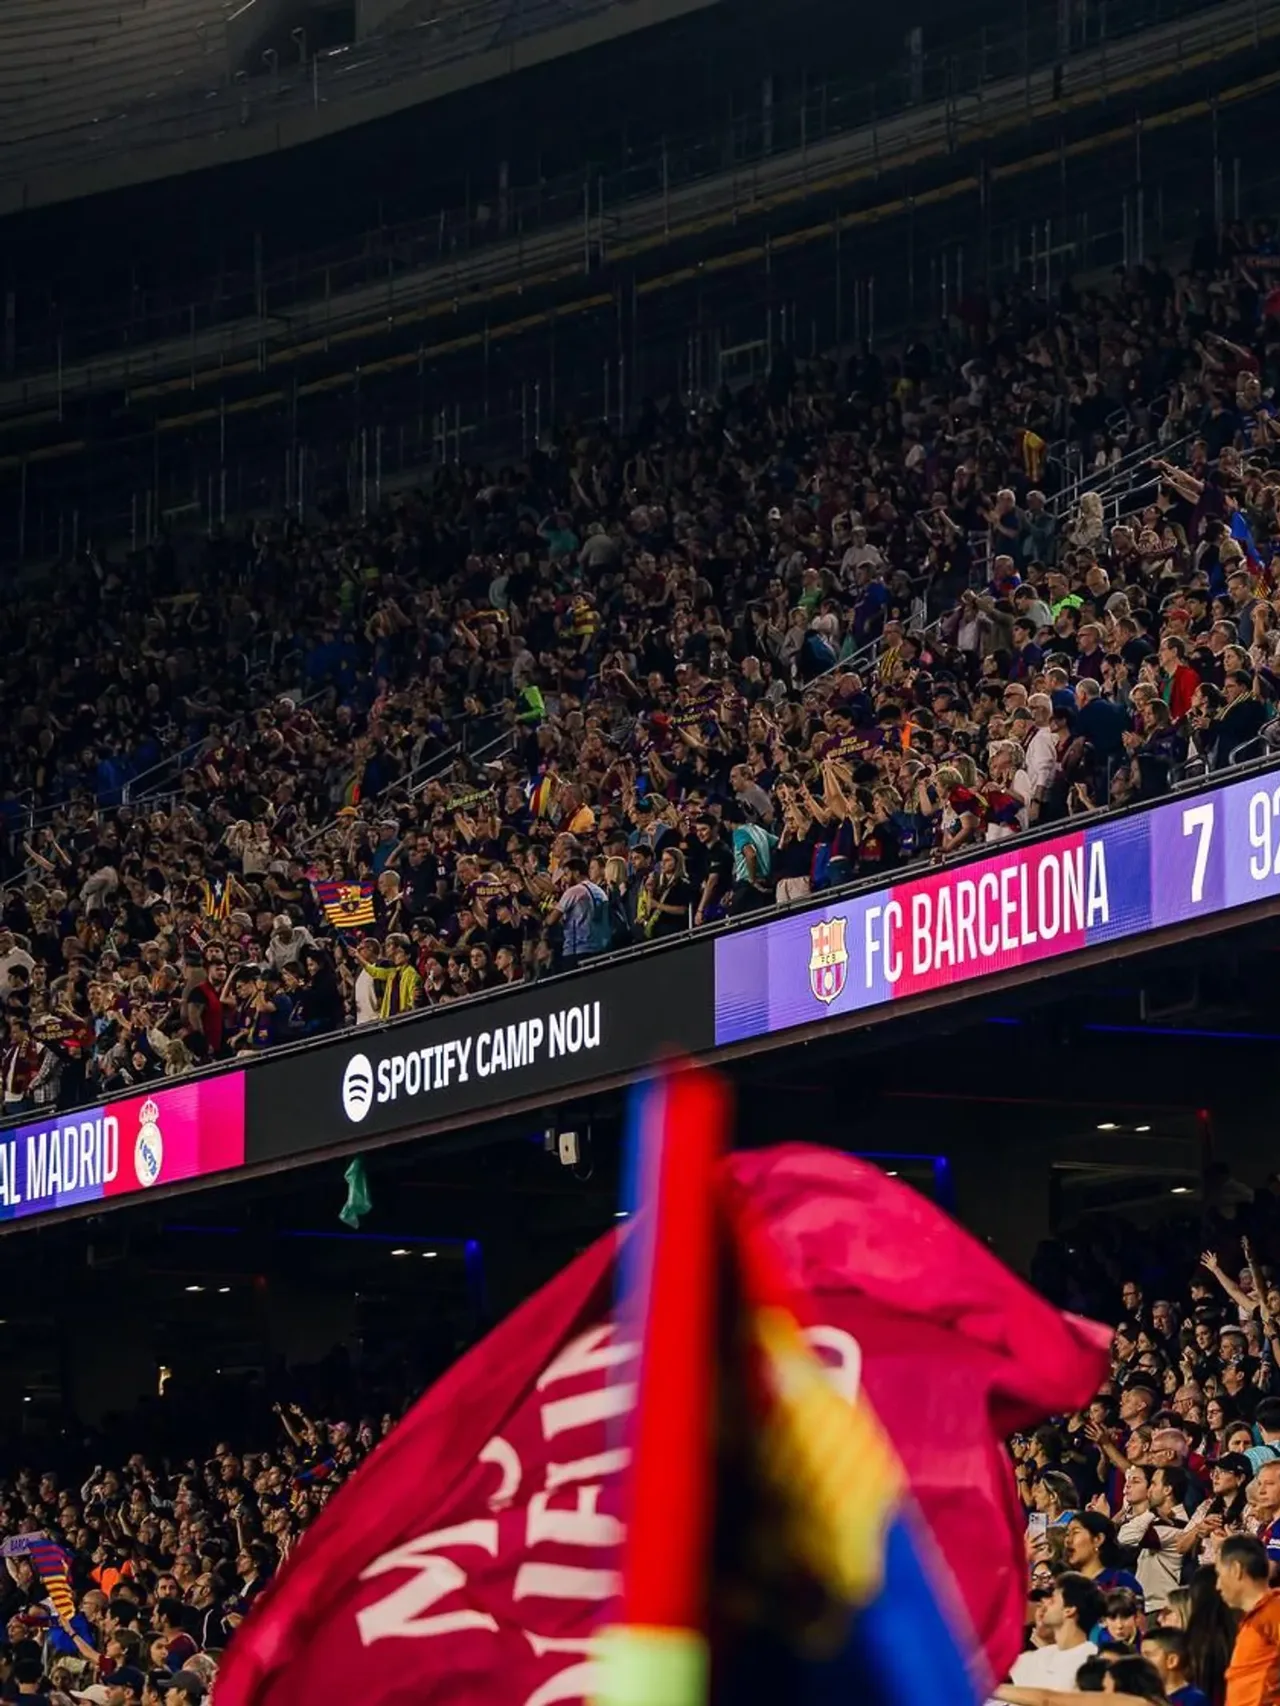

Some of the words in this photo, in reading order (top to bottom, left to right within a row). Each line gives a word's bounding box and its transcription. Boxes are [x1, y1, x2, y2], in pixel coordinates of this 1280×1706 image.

[1182, 802, 1214, 903] 7
[865, 901, 903, 989] FC
[912, 839, 1110, 974] BARCELONA
[377, 1036, 472, 1103] SPOTIFY
[476, 1017, 544, 1077] CAMP
[549, 1001, 601, 1058] NOU
[26, 1116, 119, 1201] MADRID
